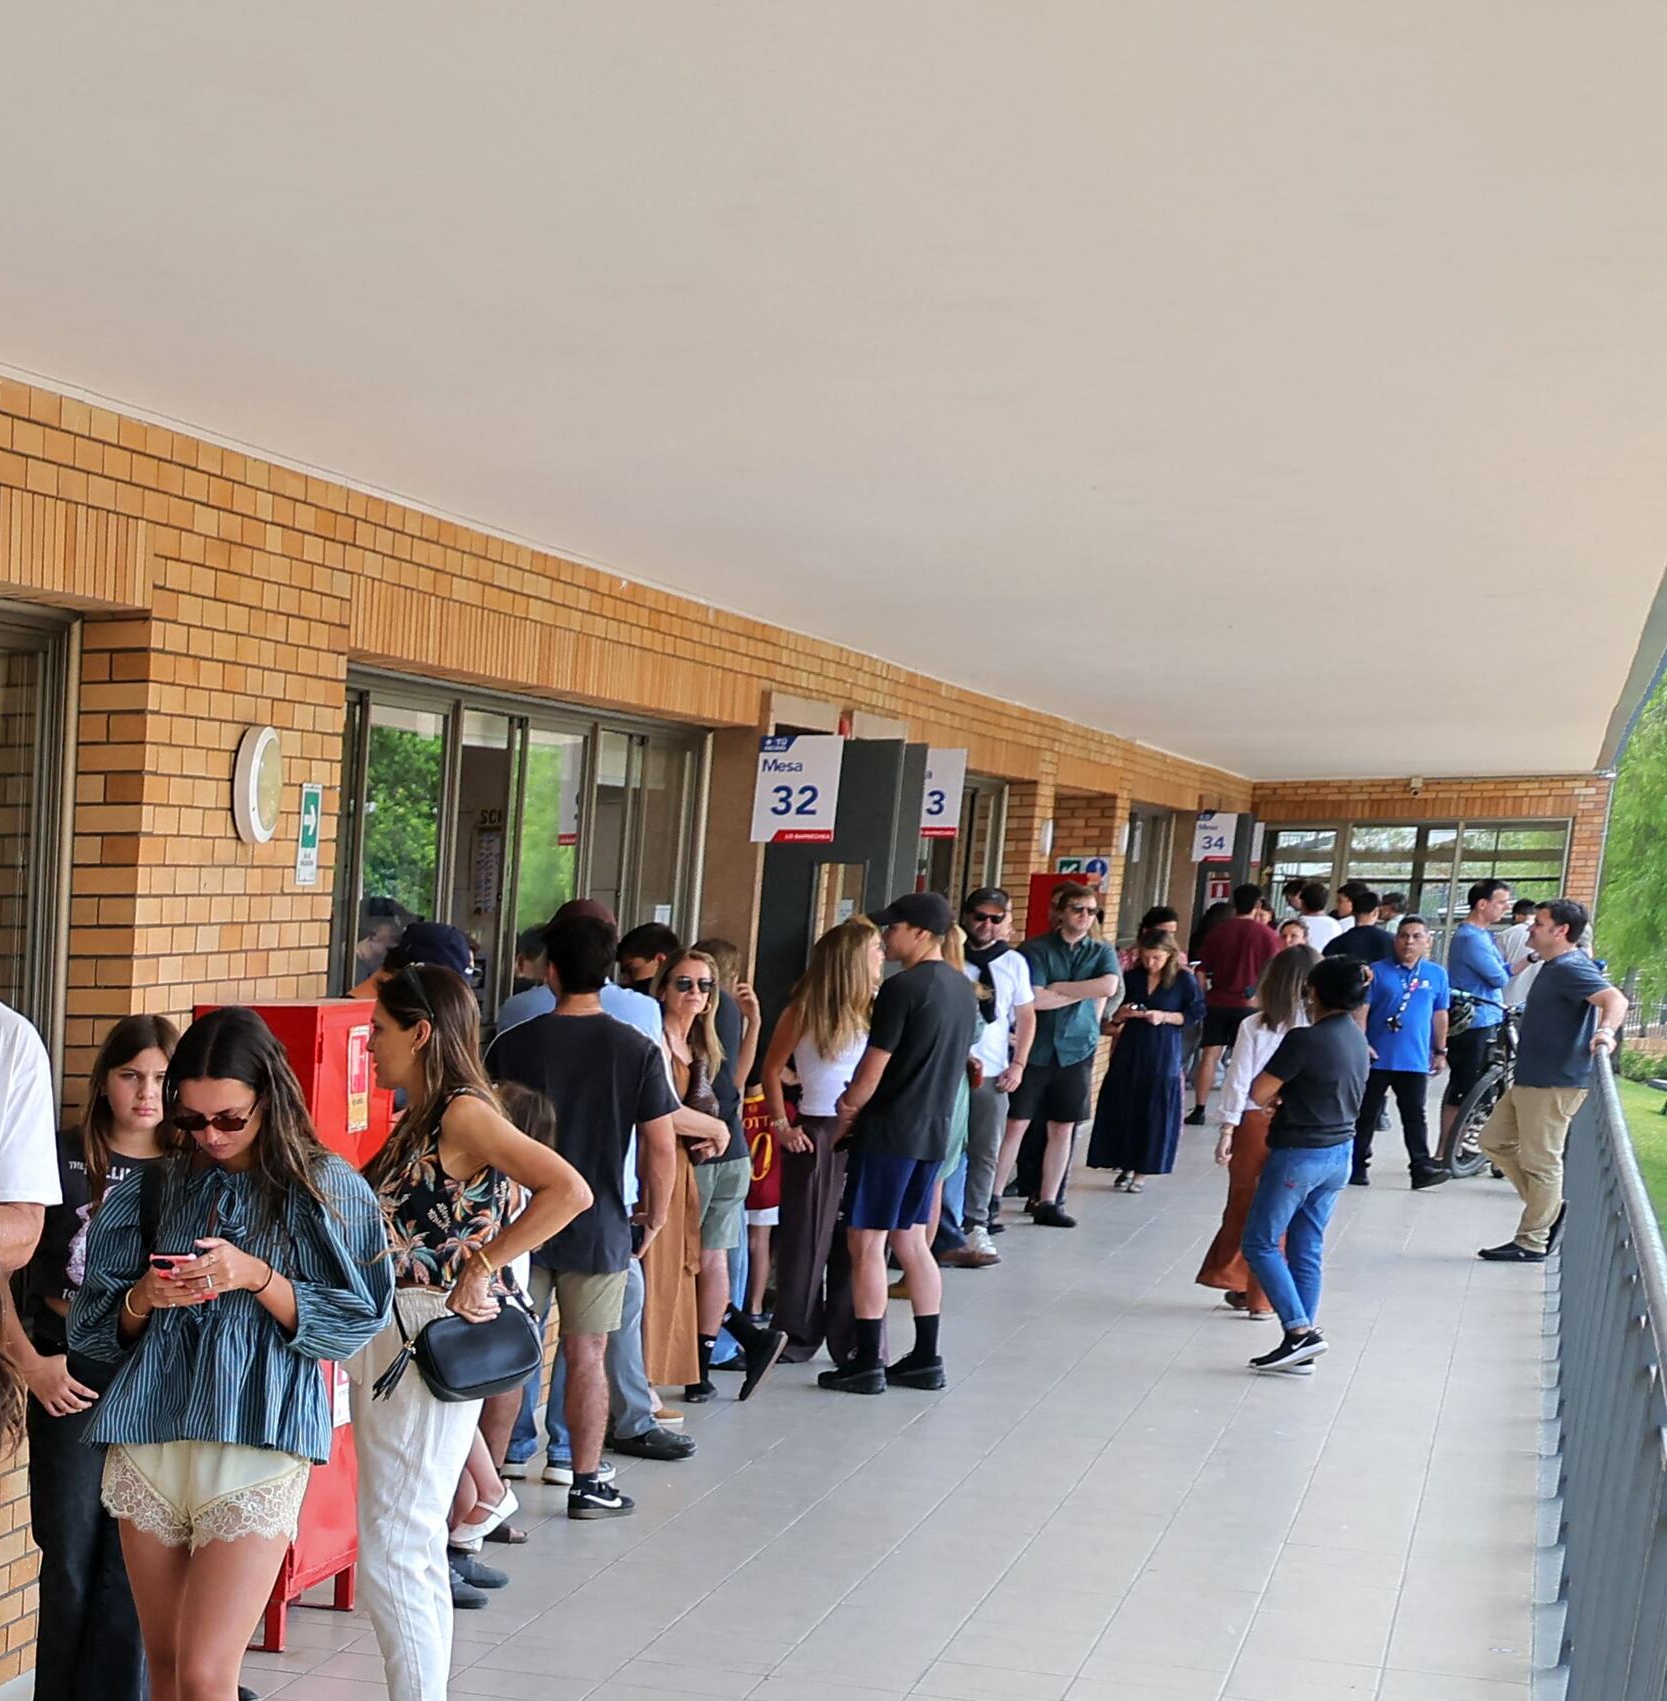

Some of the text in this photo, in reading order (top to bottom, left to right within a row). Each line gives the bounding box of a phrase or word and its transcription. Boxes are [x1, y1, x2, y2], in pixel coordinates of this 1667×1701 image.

[761, 759, 803, 772] Mesa
[770, 785, 819, 815] 32
[1202, 835, 1225, 850] 34
